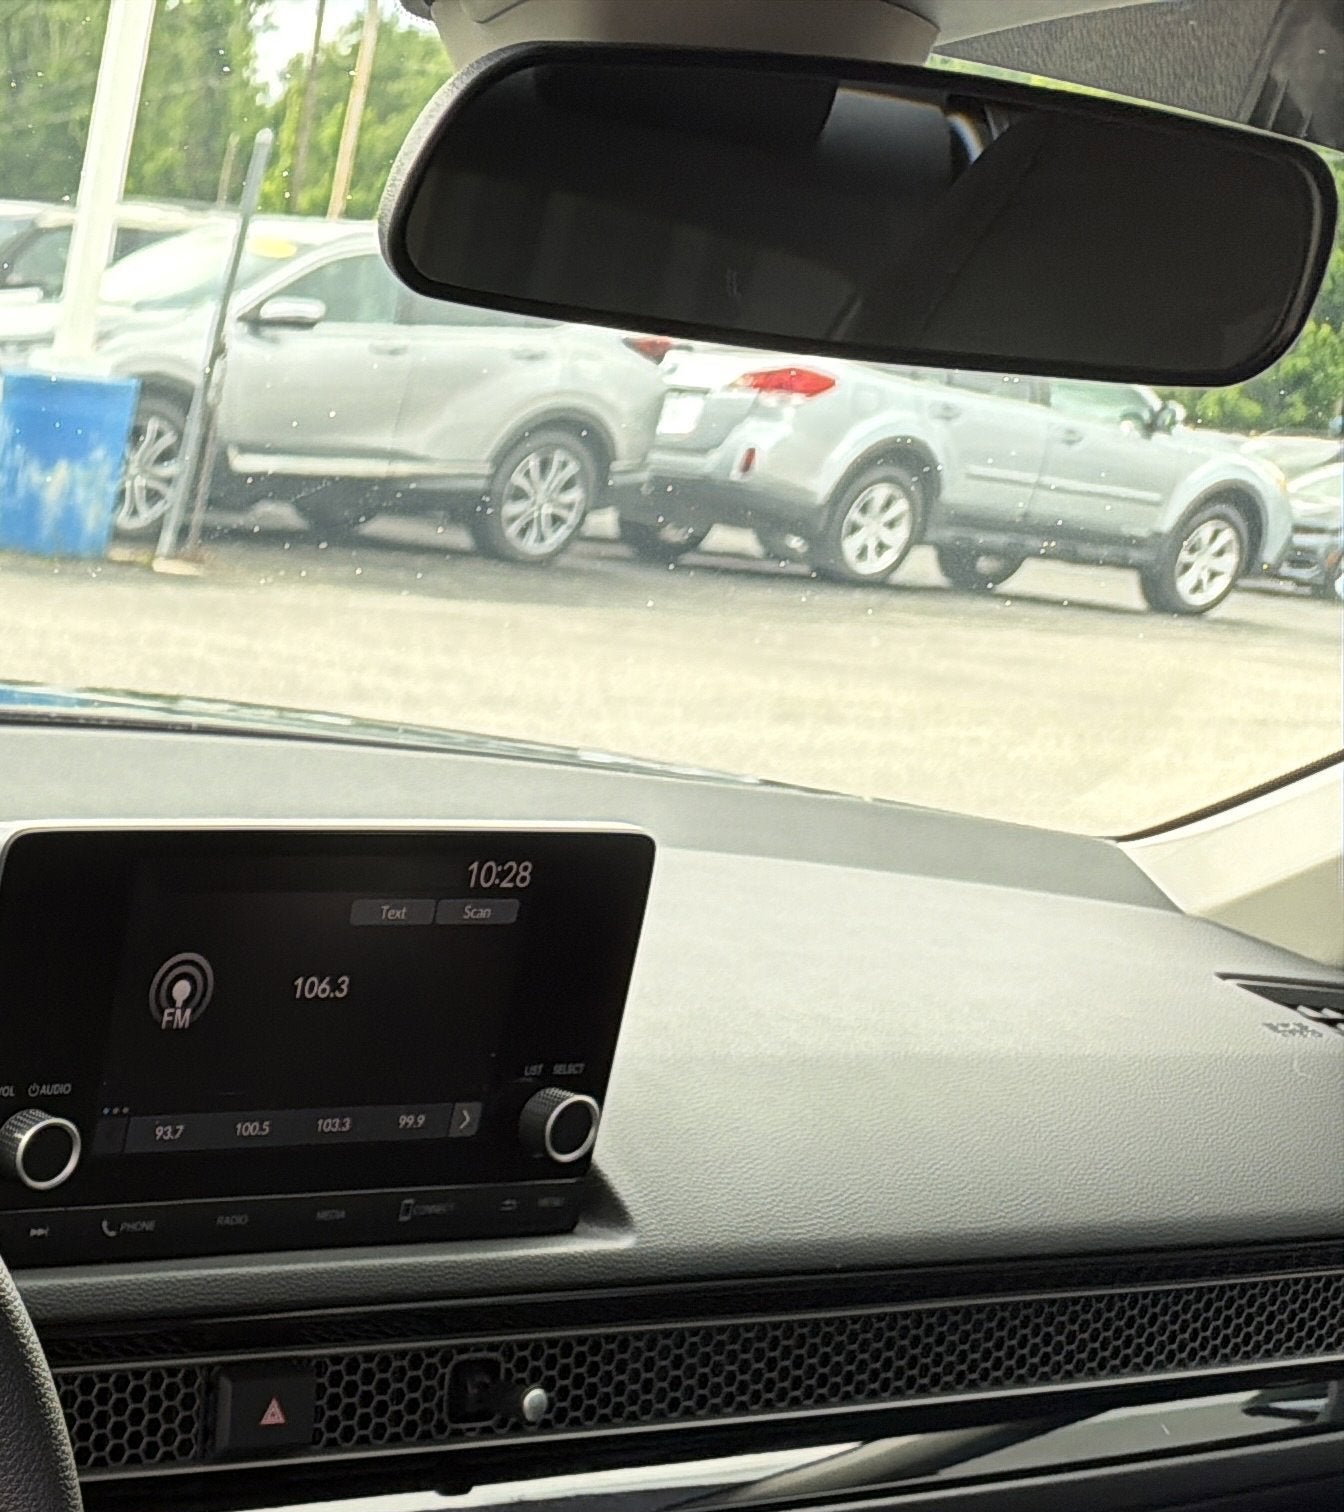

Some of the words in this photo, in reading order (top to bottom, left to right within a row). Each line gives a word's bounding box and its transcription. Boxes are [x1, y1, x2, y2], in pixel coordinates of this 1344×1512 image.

[468, 861, 533, 888] 10:28
[381, 905, 407, 920] Text
[463, 905, 492, 919] Scan
[293, 975, 350, 999] 106.3
[161, 1008, 192, 1029] FM
[39, 1083, 72, 1095] AUDIO
[155, 1124, 185, 1142] 93.7
[235, 1120, 271, 1137] 100.5
[316, 1117, 352, 1132] 103.3
[398, 1113, 426, 1129] 99.9
[119, 1219, 156, 1233] PHONE
